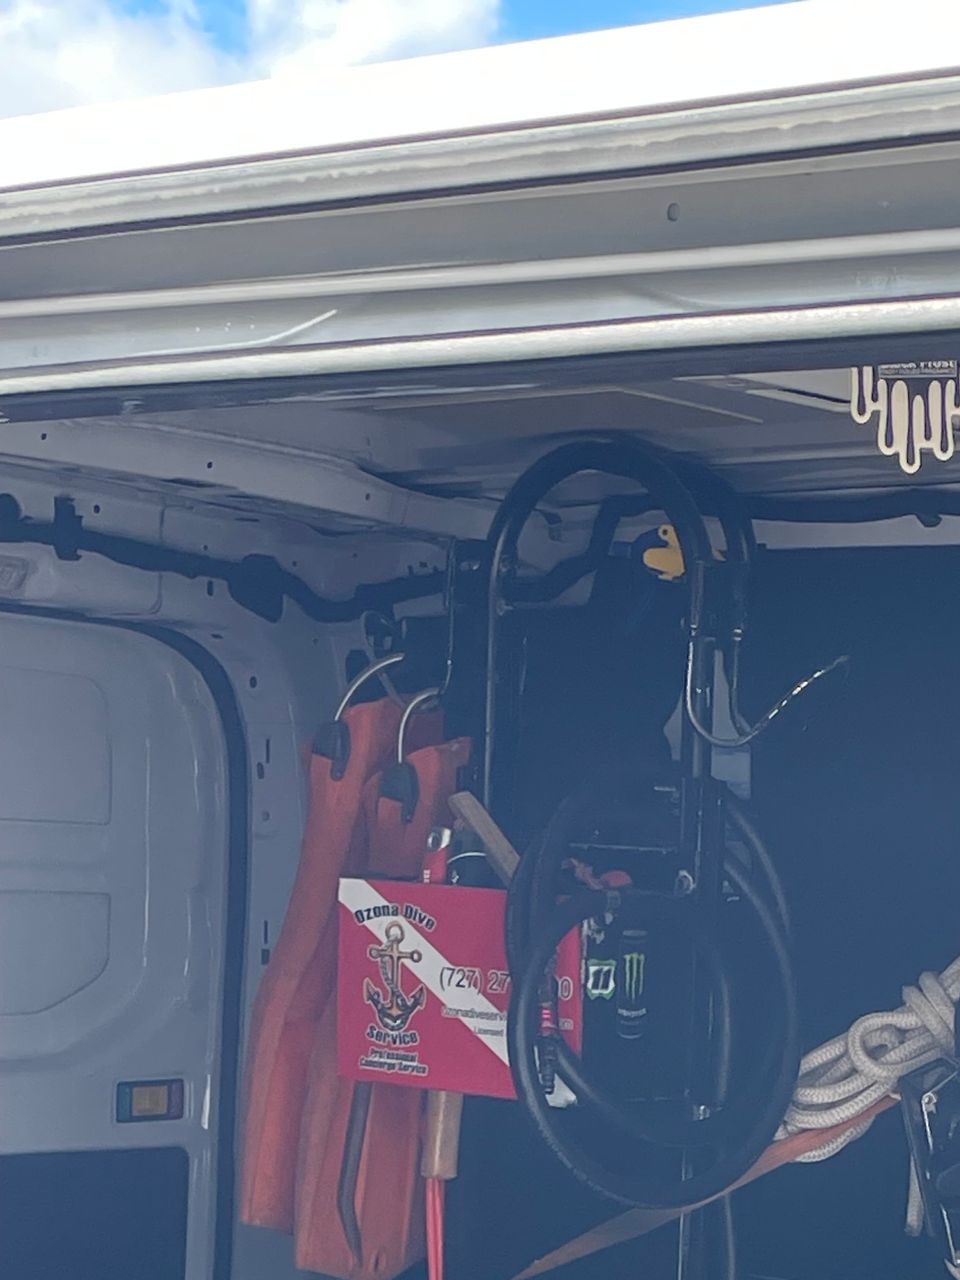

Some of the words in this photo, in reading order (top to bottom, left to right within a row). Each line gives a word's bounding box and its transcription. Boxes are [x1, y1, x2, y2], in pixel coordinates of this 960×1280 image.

[354, 904, 400, 924] Ozona
[403, 903, 436, 930] Dive
[439, 966, 483, 995] (727)
[366, 1025, 418, 1045] Service
